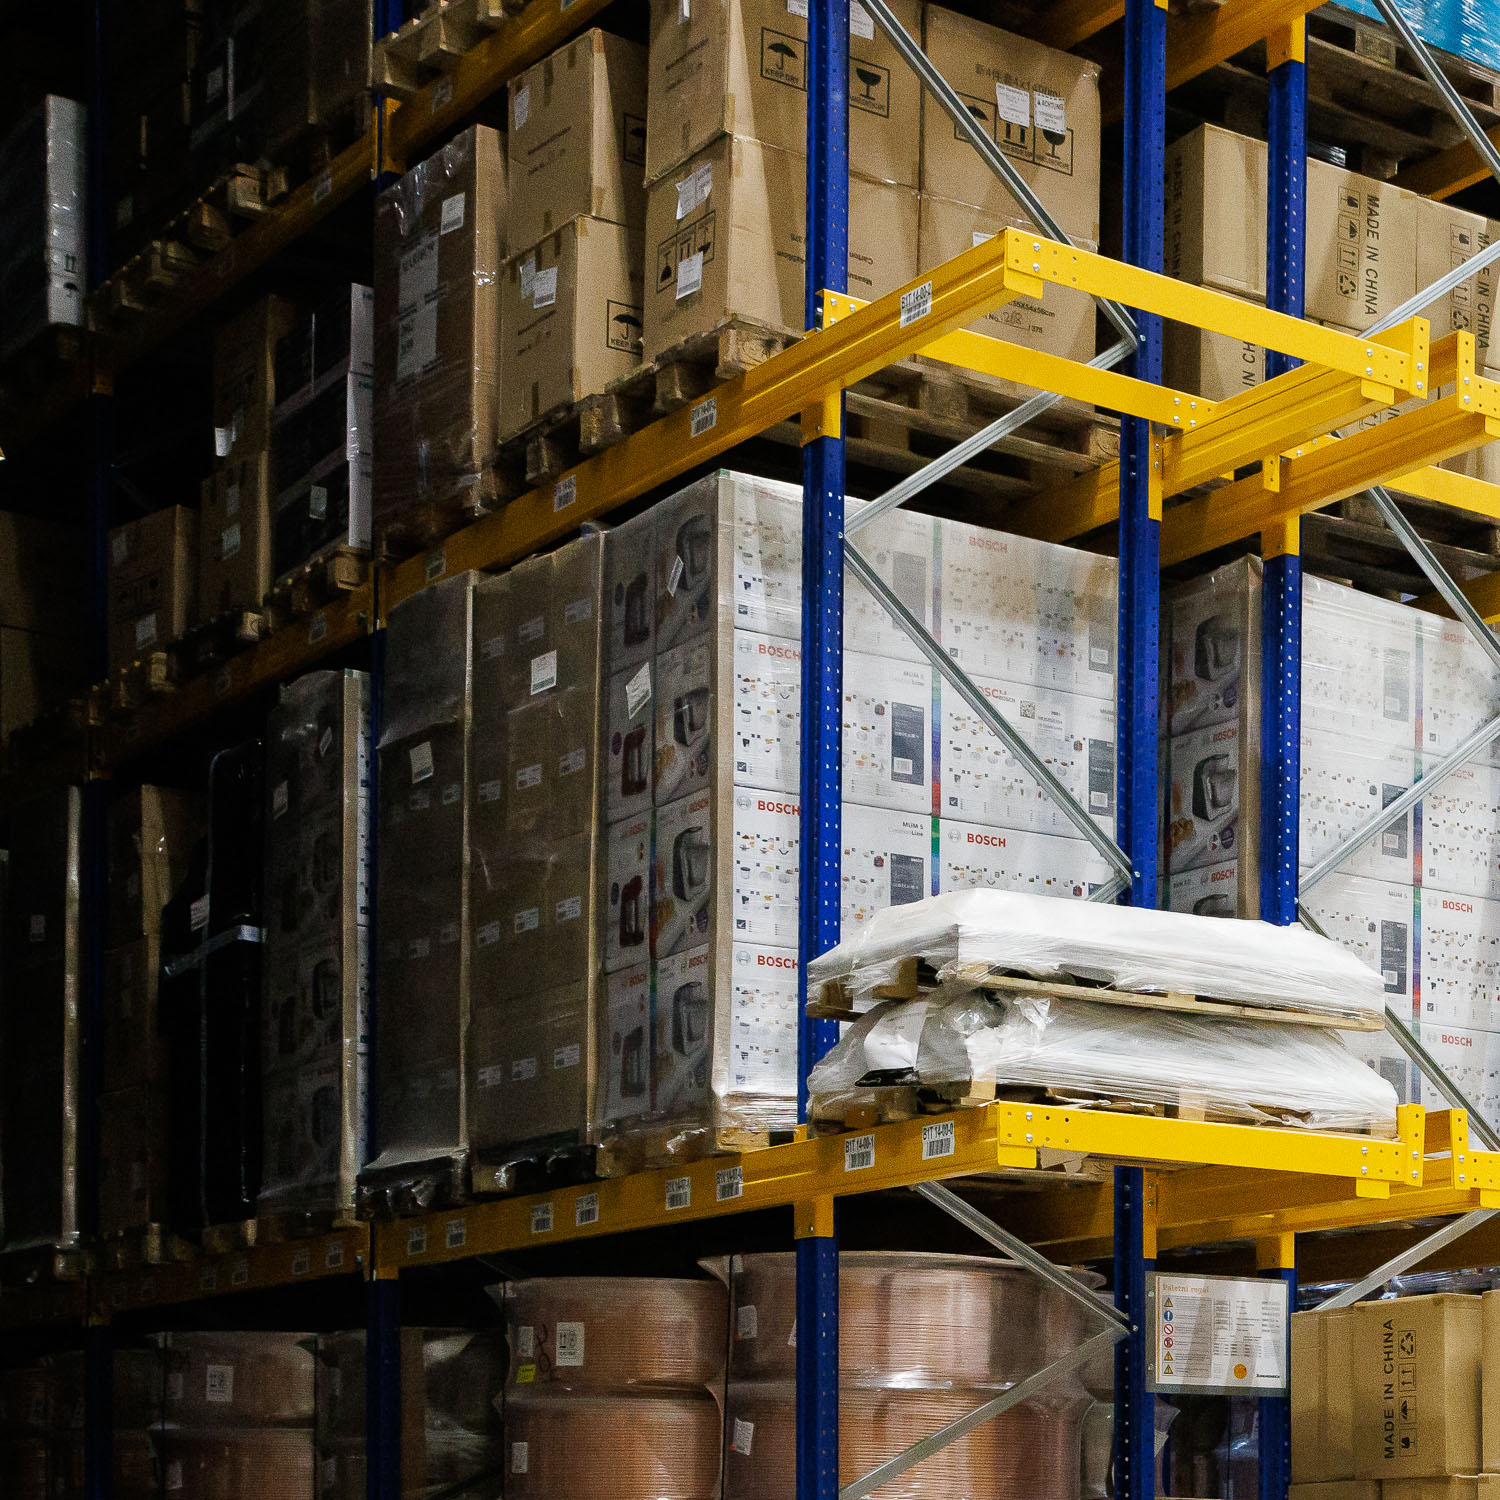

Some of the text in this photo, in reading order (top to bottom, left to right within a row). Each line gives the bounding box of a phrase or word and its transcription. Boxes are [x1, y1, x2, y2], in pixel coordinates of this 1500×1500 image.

[1366, 195, 1379, 316] MADE IN CHINA
[1477, 281, 1489, 298] IN
[901, 294, 915, 310] B1T
[1477, 304, 1489, 349] CHINA
[968, 536, 1008, 553] BOSCH
[1212, 726, 1237, 742] BOSCH
[757, 800, 801, 817] BOSCH
[966, 832, 1007, 848] BOSCH
[1210, 869, 1235, 881] BOSCH
[1442, 900, 1473, 912] BOSCH
[1441, 1034, 1473, 1046] BOSCH
[922, 1126, 936, 1141] B1T
[845, 1140, 857, 1154] B1T
[1383, 1319, 1395, 1460] MADE IN CHINA
